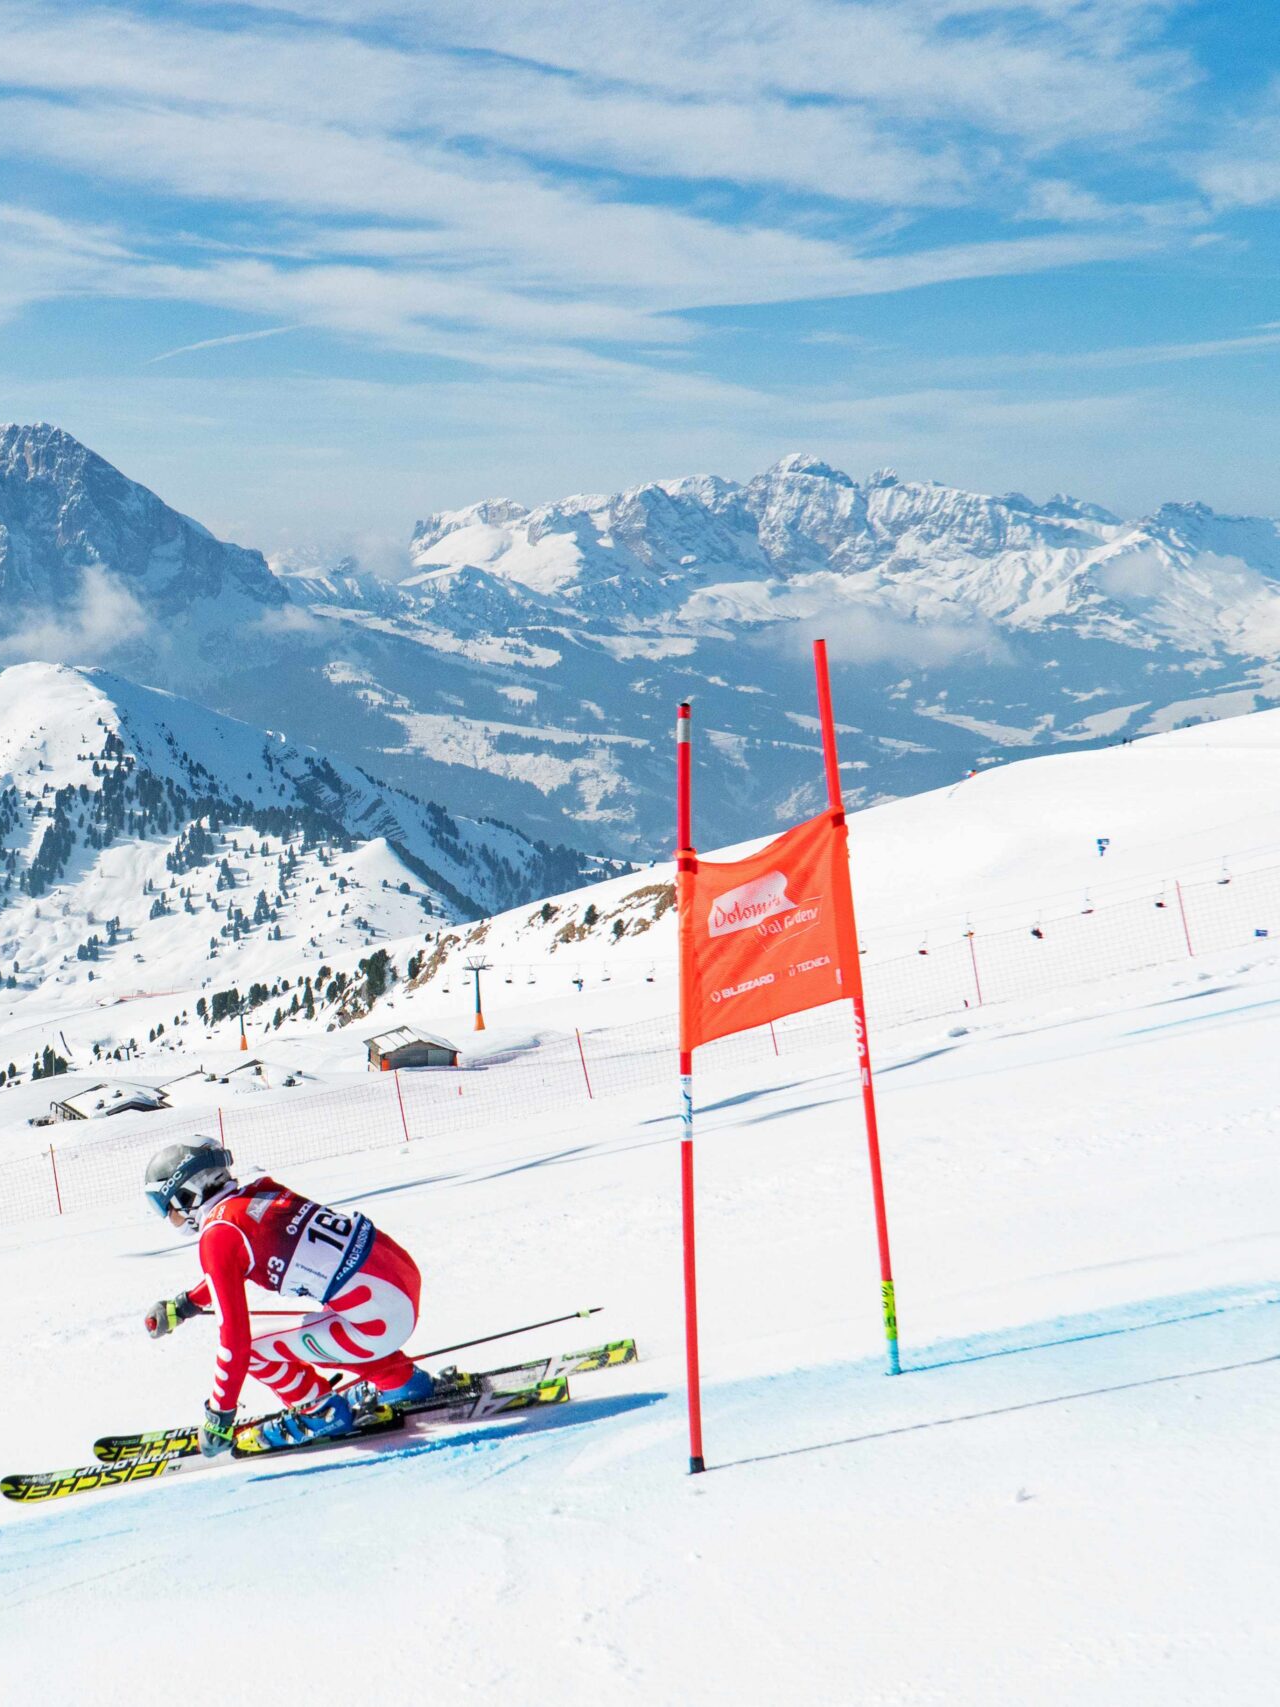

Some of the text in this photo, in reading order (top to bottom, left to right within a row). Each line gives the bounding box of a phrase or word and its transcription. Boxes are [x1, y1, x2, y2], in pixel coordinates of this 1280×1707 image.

[721, 972, 775, 999] BLIZZARD
[307, 1207, 353, 1252] 16
[1, 1461, 169, 1500] FISCHER
